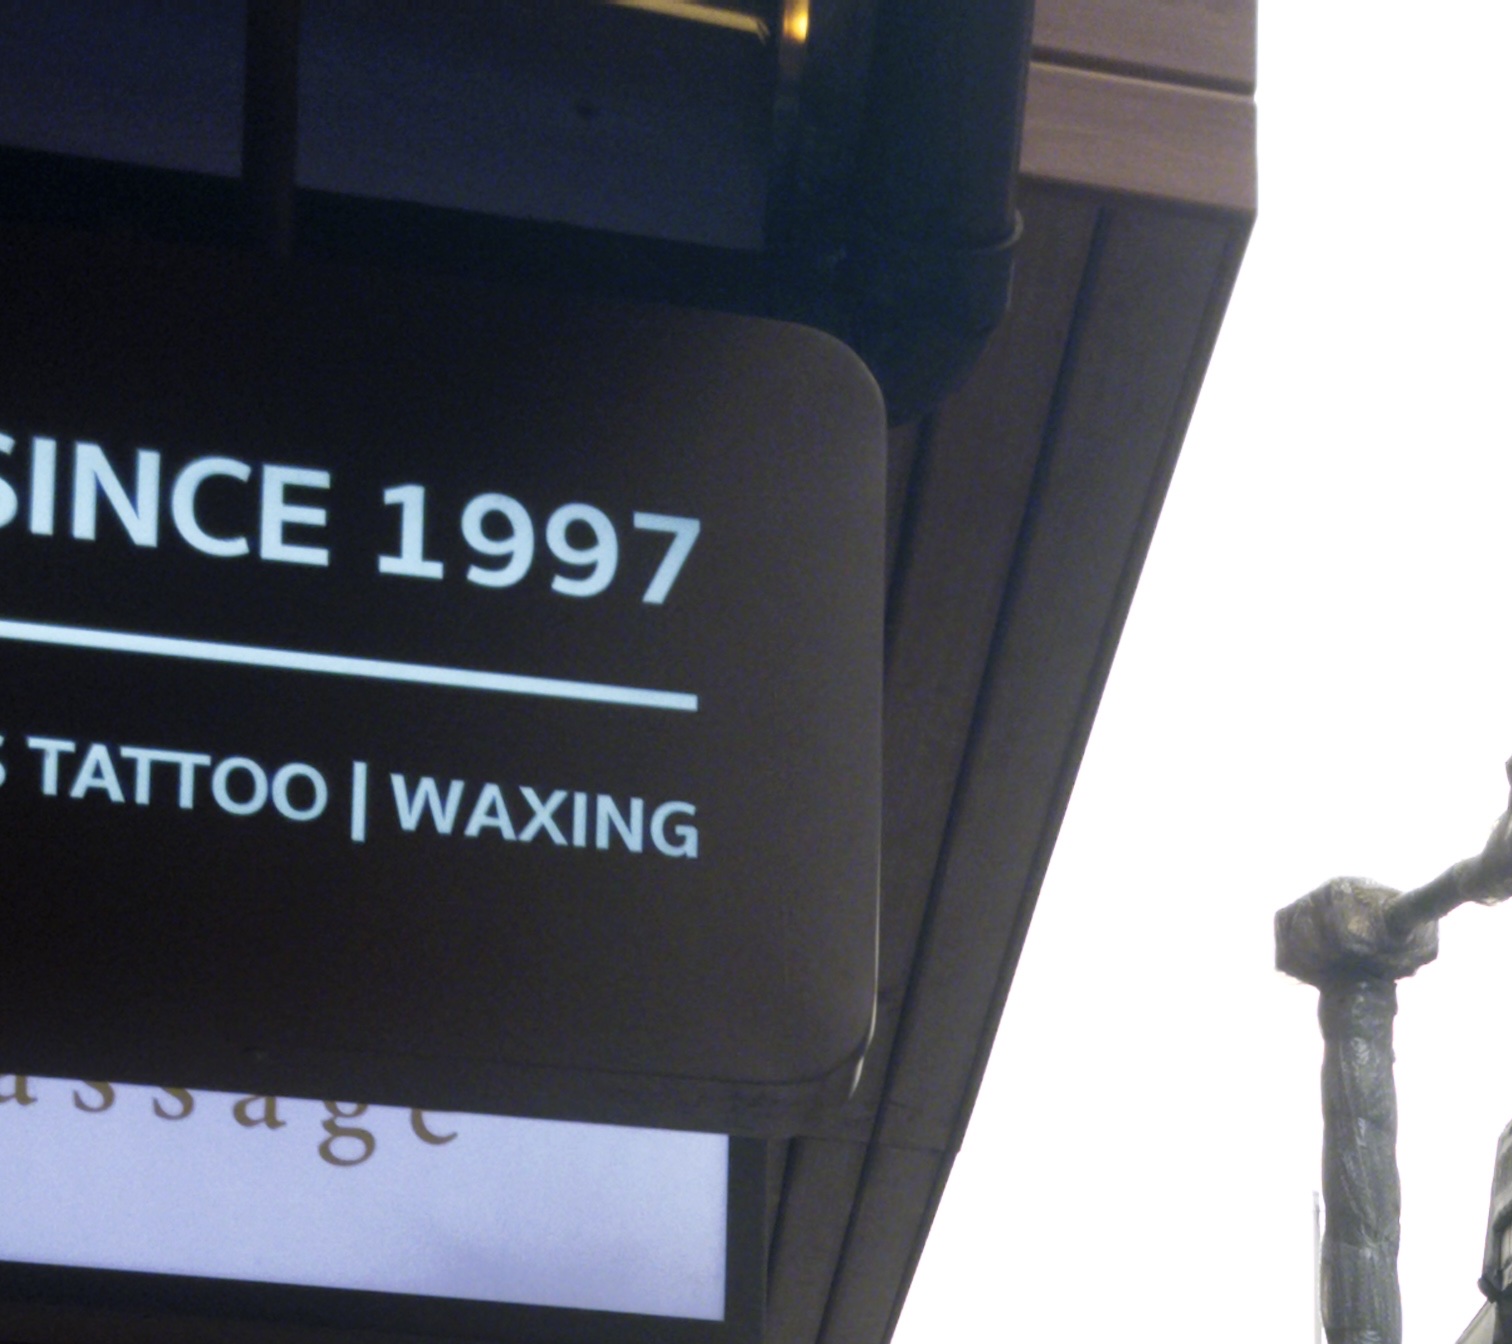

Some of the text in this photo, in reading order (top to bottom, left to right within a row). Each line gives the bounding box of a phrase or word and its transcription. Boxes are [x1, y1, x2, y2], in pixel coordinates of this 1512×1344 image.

[377, 482, 702, 605] 1997
[27, 736, 328, 822] TATTOO
[390, 773, 699, 859] WAXING
